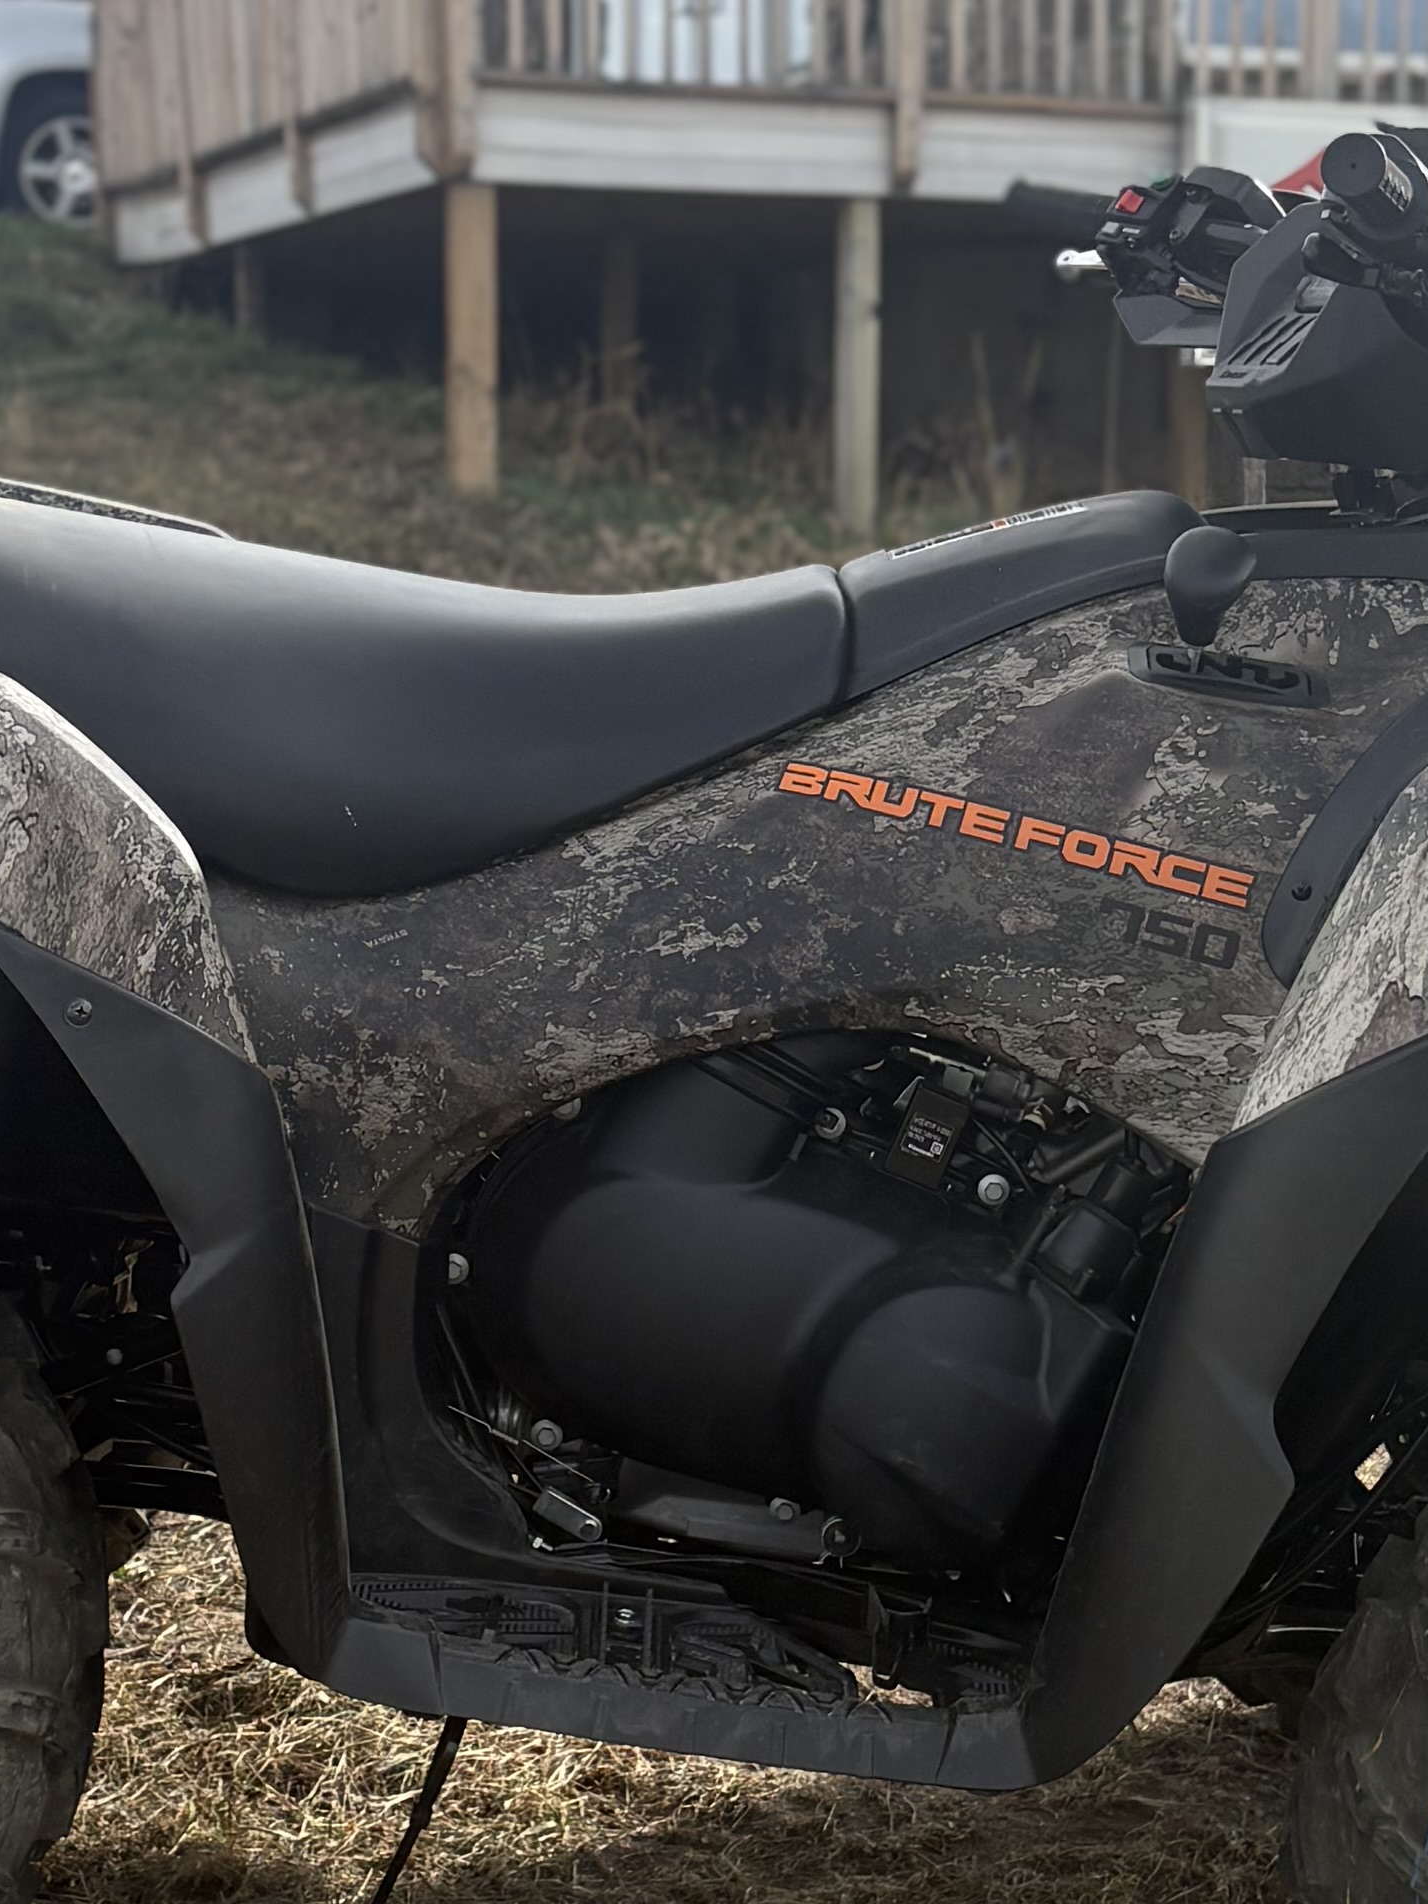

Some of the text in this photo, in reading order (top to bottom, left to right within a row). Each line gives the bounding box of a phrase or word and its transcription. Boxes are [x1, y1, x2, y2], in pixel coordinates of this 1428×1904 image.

[777, 761, 1256, 909] BRUTE FORCE
[1100, 898, 1241, 970] 750
